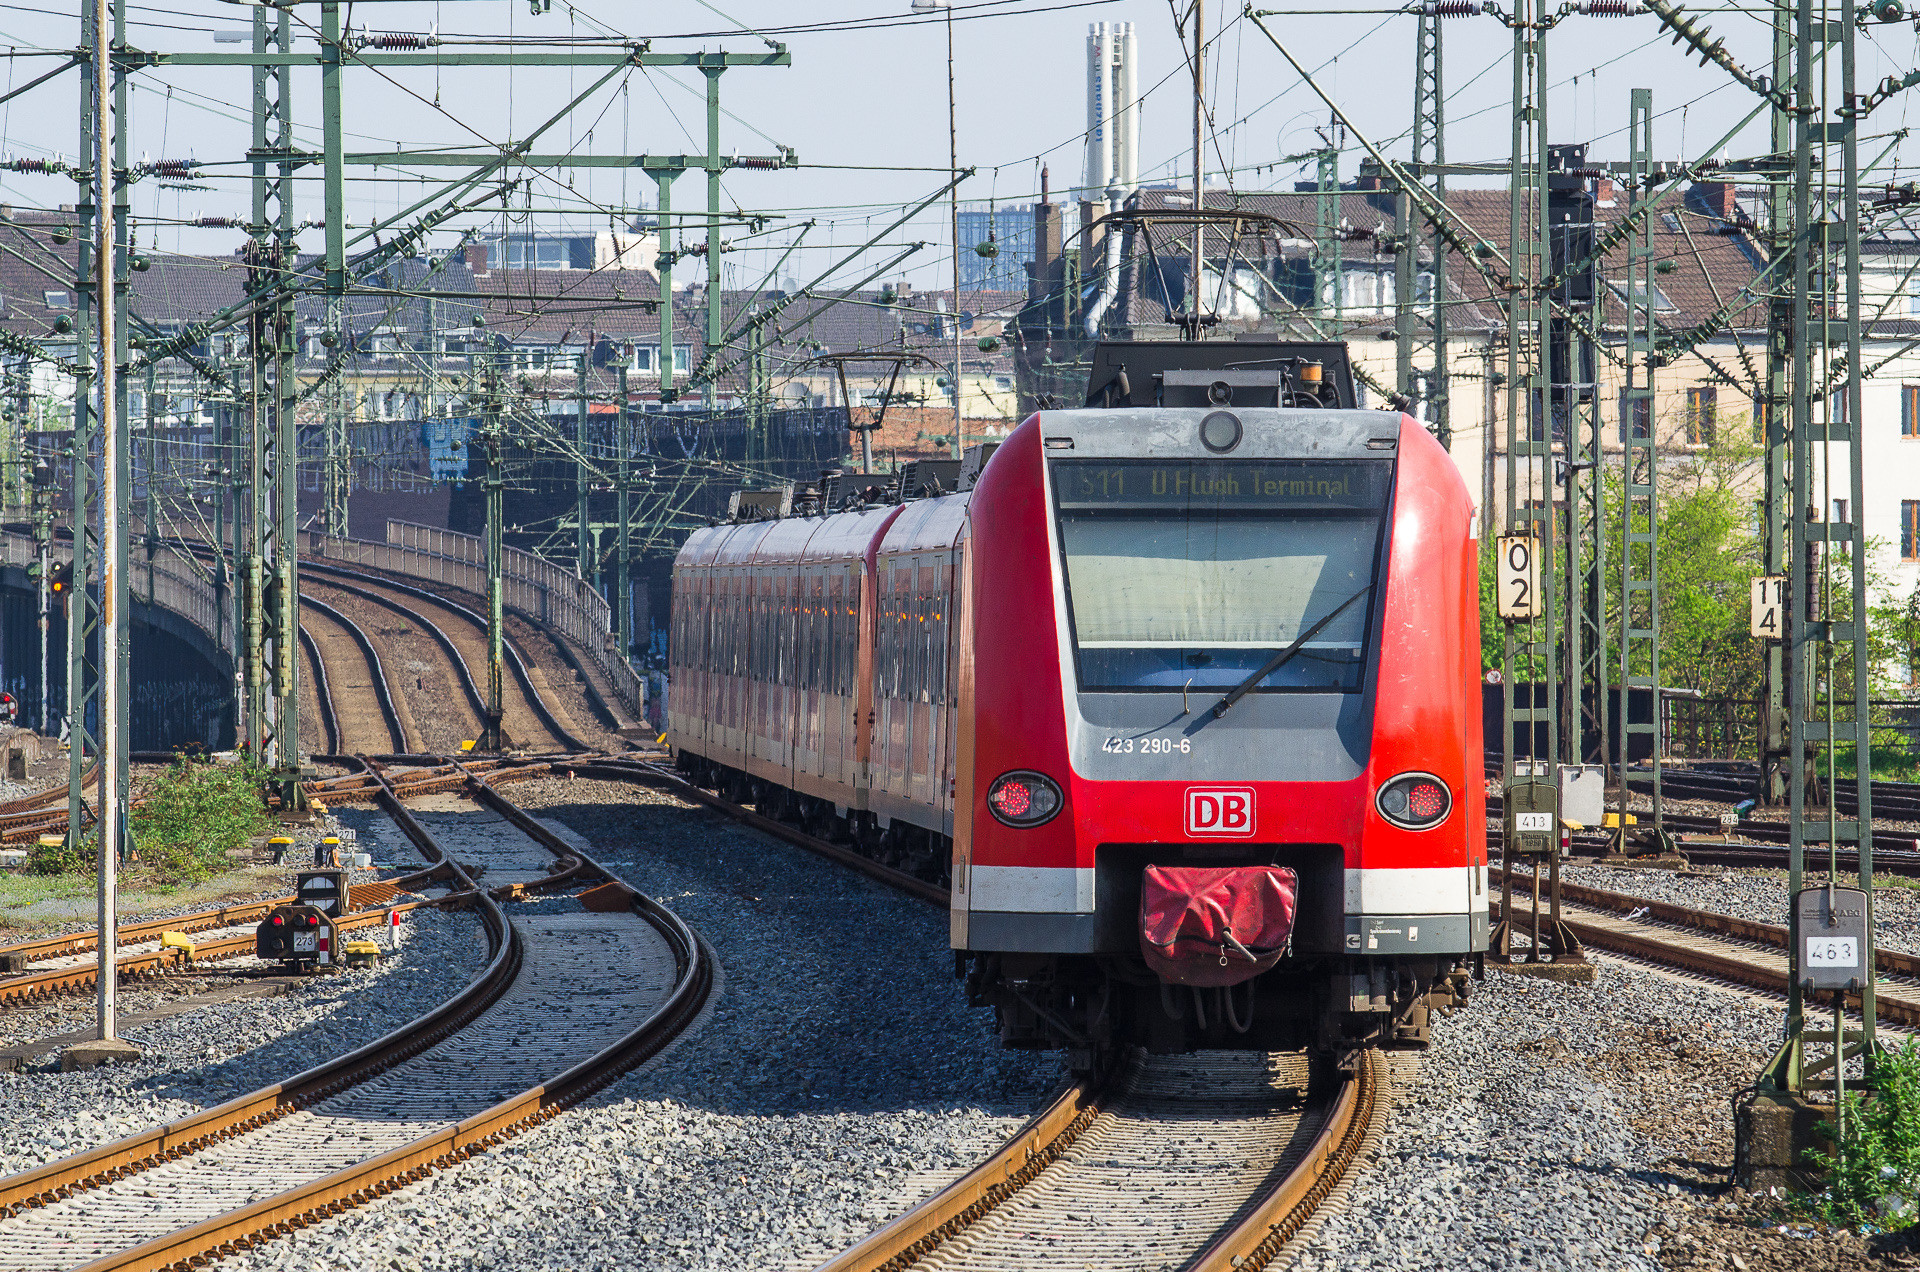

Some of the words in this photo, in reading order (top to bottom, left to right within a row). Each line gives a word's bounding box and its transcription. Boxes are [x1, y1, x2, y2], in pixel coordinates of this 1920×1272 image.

[1250, 469, 1351, 495] Terminal
[1508, 543, 1529, 572] 0
[1510, 578, 1530, 608] 2
[1758, 579, 1782, 605] 11
[1759, 607, 1777, 633] 4
[1102, 737, 1134, 754] 423
[1140, 738, 1191, 754] 290-6
[1193, 795, 1248, 829] DB
[1522, 816, 1546, 828] 413
[338, 830, 354, 839] 271
[1839, 909, 1862, 917] AEG
[296, 936, 313, 946] 273
[1812, 943, 1851, 960] 463
